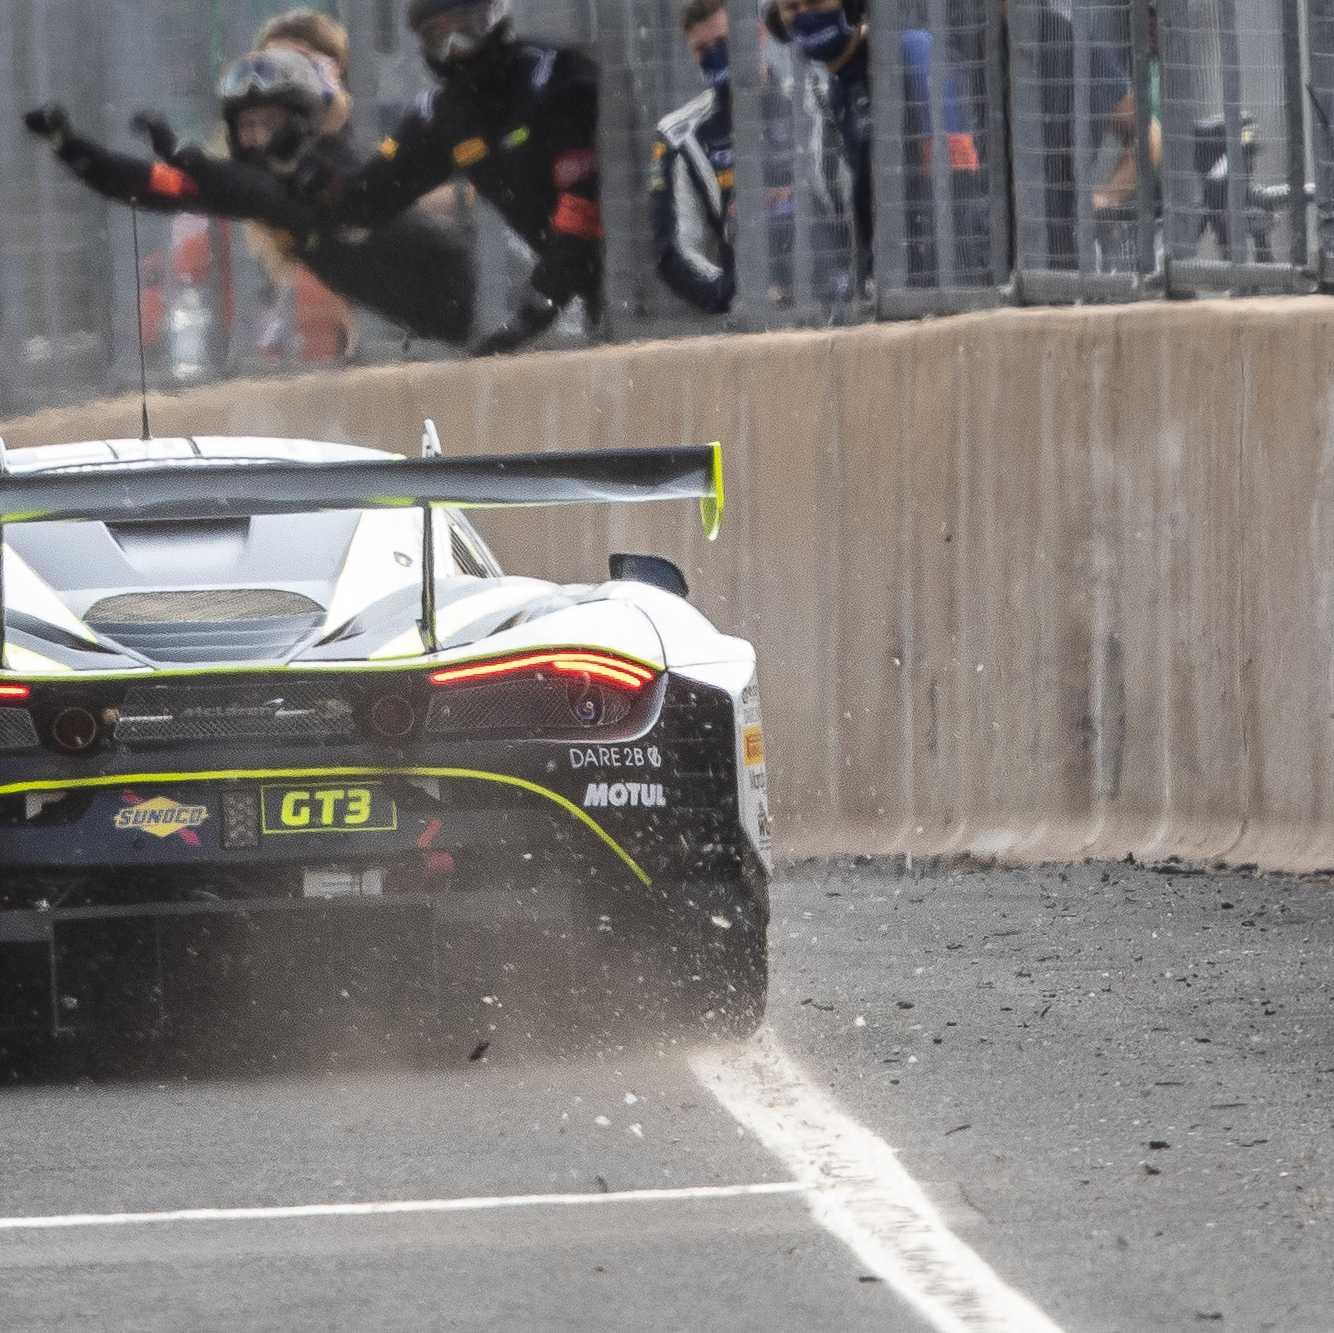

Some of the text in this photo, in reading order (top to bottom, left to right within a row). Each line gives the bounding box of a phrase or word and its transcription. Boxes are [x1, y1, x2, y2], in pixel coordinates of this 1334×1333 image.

[569, 747, 645, 769] DARE 2B
[583, 782, 666, 807] MOTUL
[117, 806, 204, 825] SUNOCO
[280, 789, 372, 827] GT3
